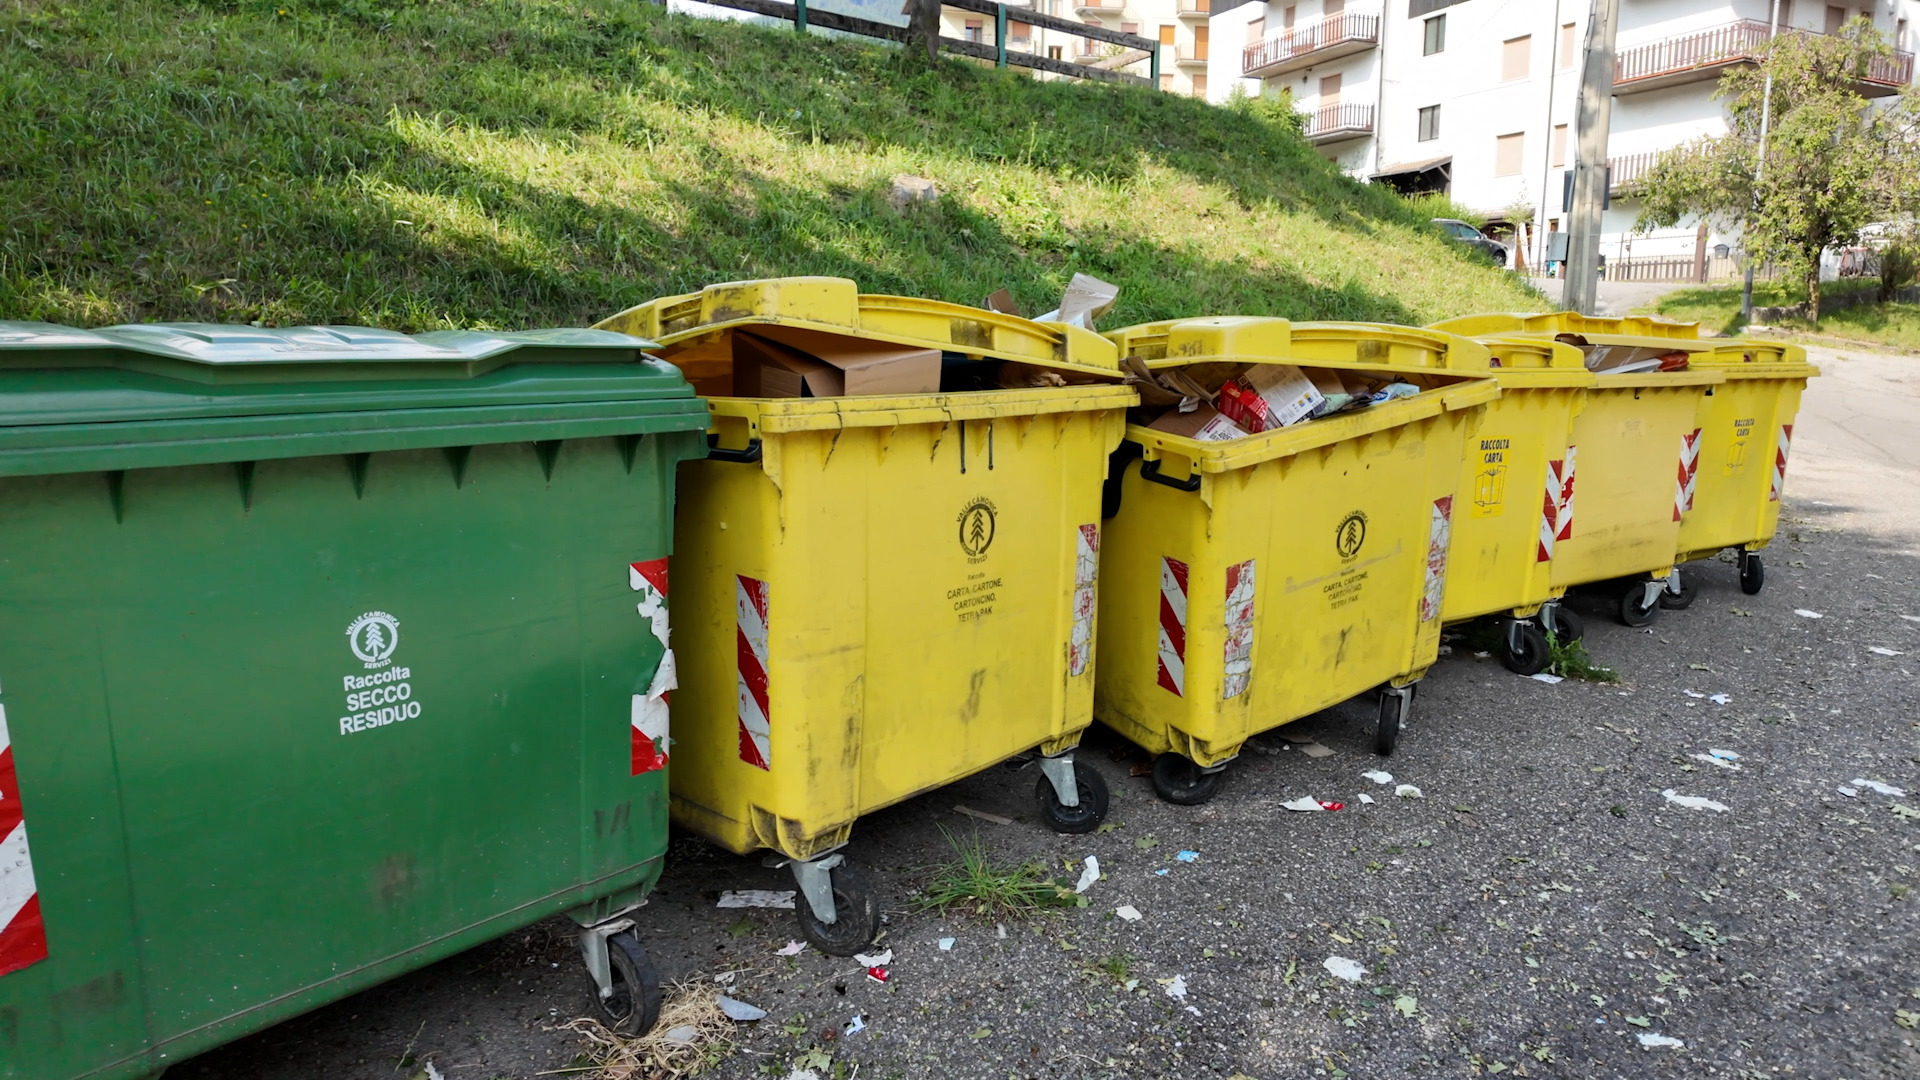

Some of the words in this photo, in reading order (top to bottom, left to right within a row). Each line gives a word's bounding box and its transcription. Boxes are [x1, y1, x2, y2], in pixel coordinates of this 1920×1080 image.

[1480, 439, 1509, 451] RACCOLTA
[1484, 452, 1503, 463] CARTA
[956, 501, 972, 523] VALLE
[972, 494, 998, 517] CAMONICA
[967, 554, 988, 565] SERVIZI
[972, 577, 1003, 593] CARTONE,
[954, 592, 996, 611] CARTONCINO,
[980, 606, 993, 615] PAK
[345, 615, 363, 636] VALLE
[363, 611, 400, 628] CAMONICA
[364, 658, 392, 669] SERVIZI
[343, 666, 411, 691] Raccolta
[346, 683, 411, 712] SECCO
[340, 701, 422, 735] RESIDUO
